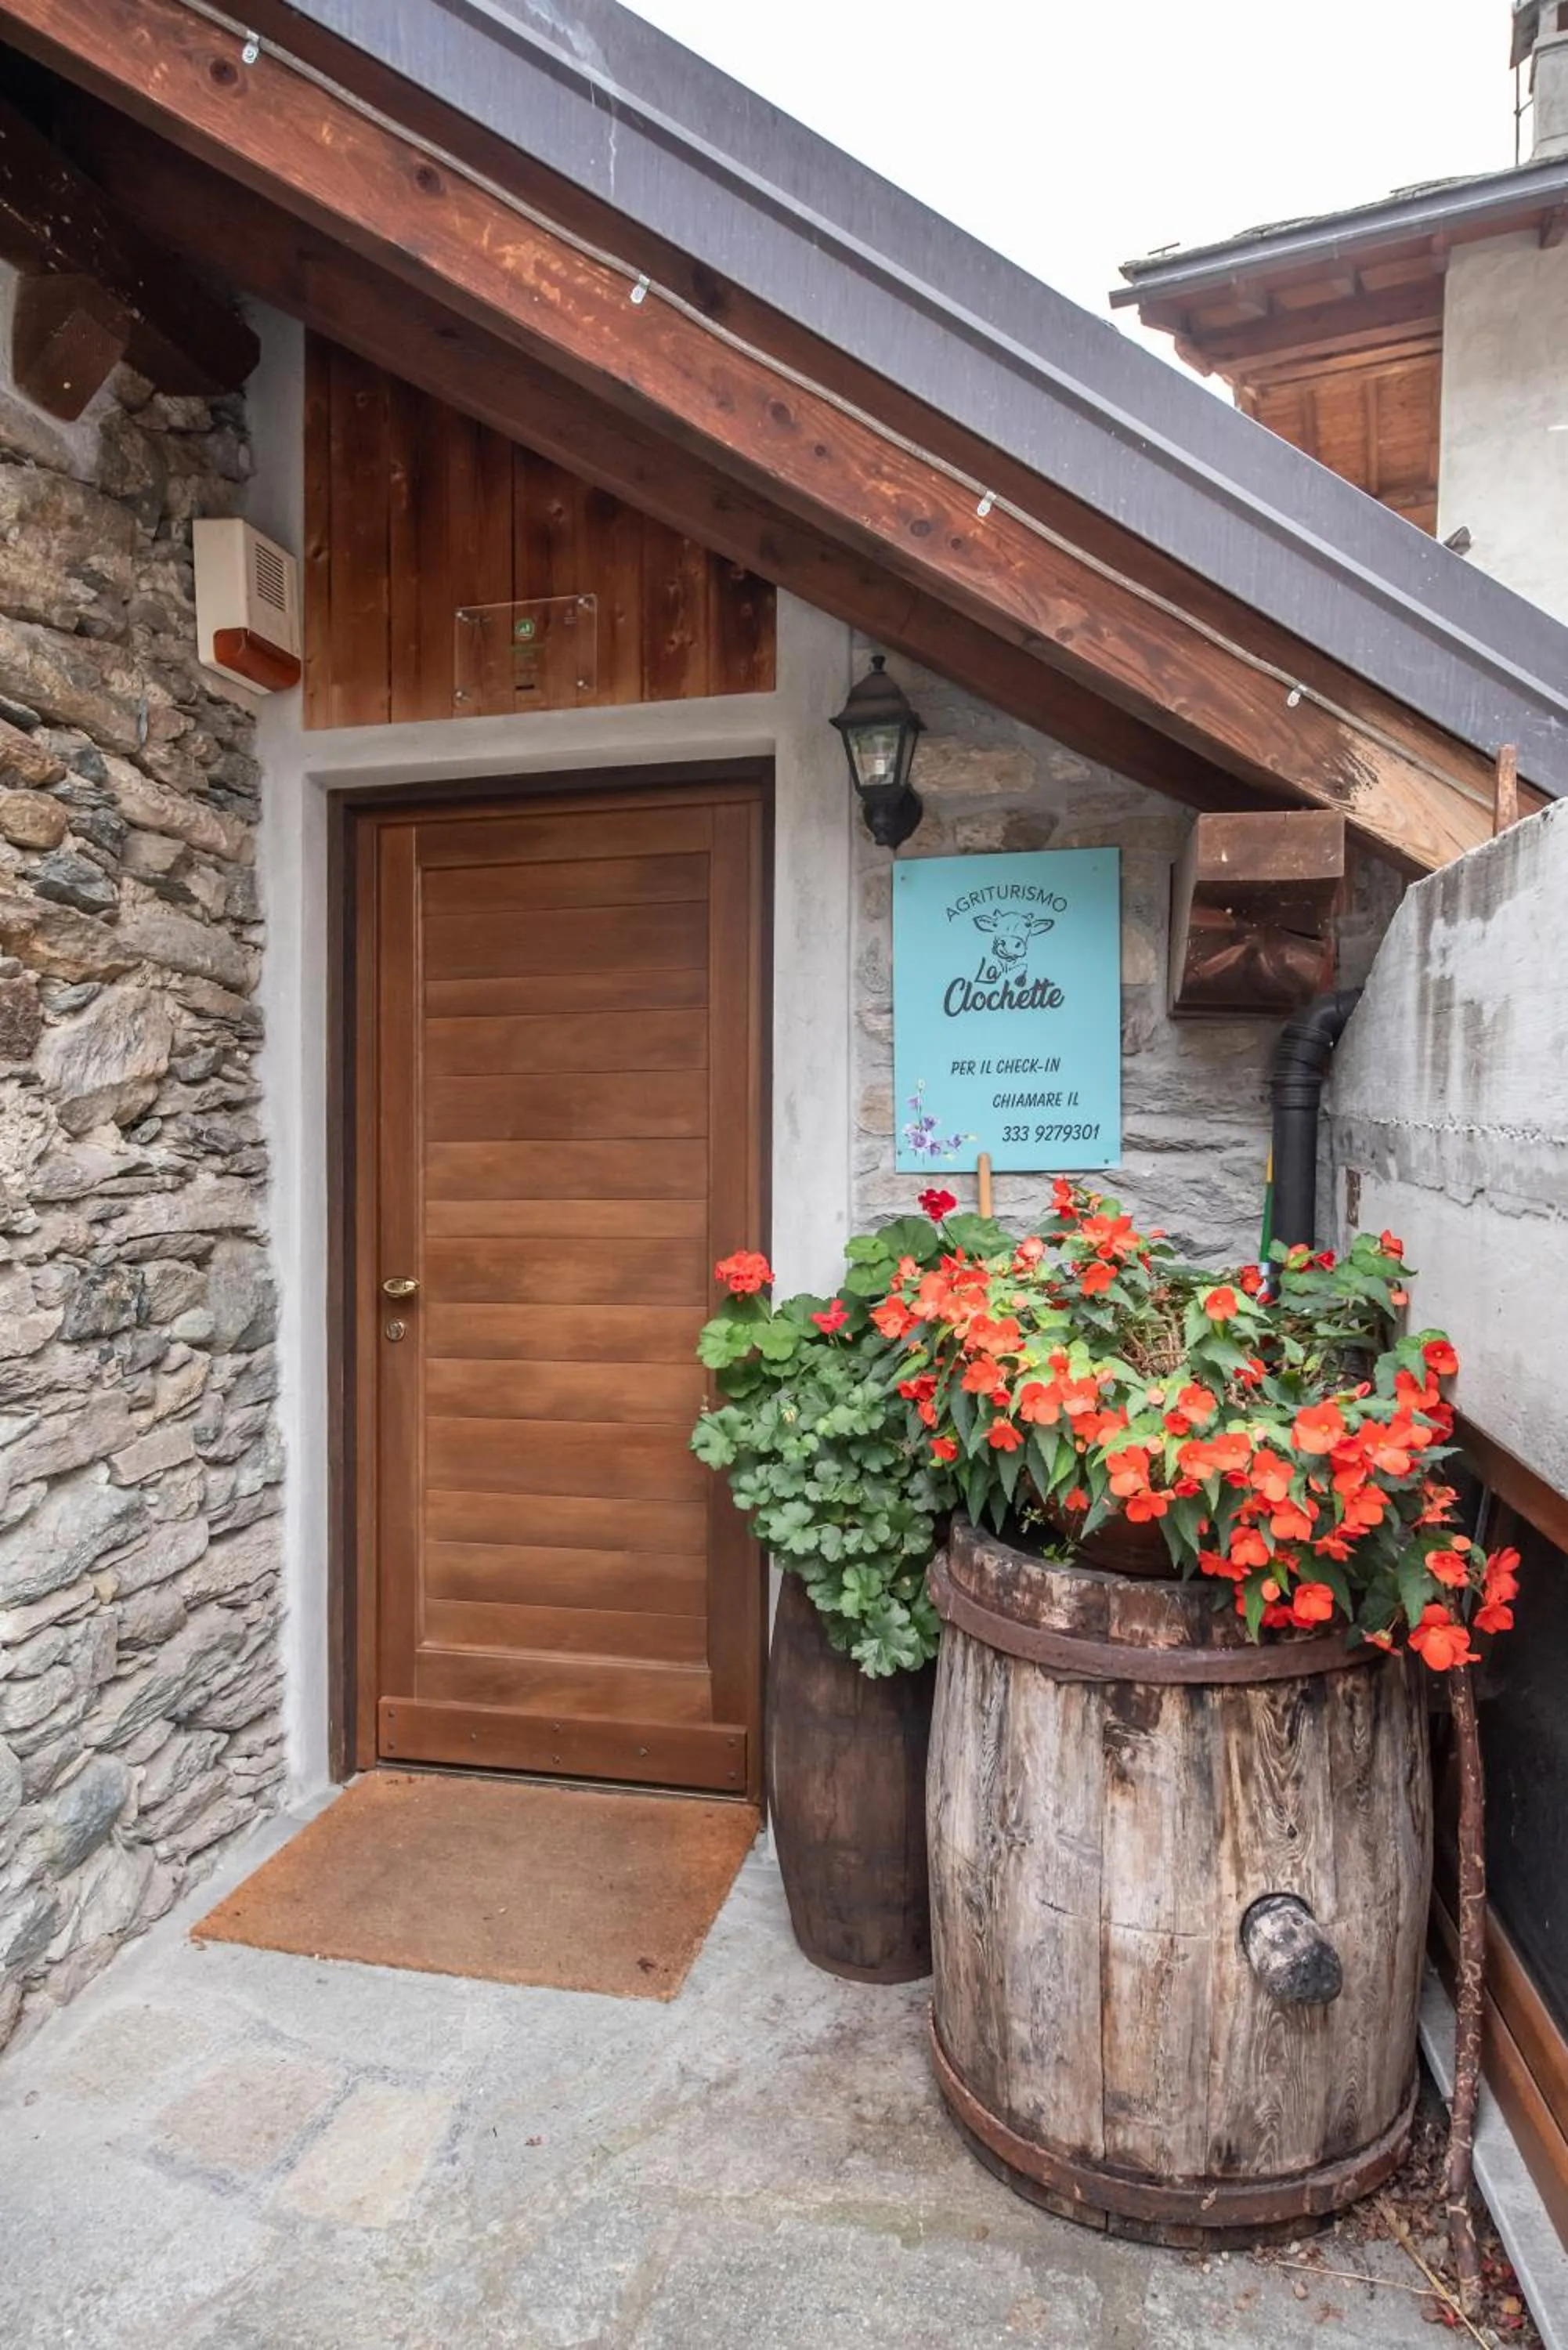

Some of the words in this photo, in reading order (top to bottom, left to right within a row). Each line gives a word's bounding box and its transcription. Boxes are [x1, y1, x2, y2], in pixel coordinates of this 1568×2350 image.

[945, 884, 1068, 921] AGRITURISMO
[974, 956, 999, 984] La
[944, 977, 1064, 1017] Clochette
[951, 1060, 975, 1076] PER
[980, 1059, 992, 1075] IL
[995, 1058, 1061, 1073] CHECK-IN
[992, 1092, 1063, 1108] CHIAMARE
[1067, 1091, 1079, 1106] IL
[1003, 1125, 1028, 1141] 333
[1035, 1123, 1100, 1143] 9279301
